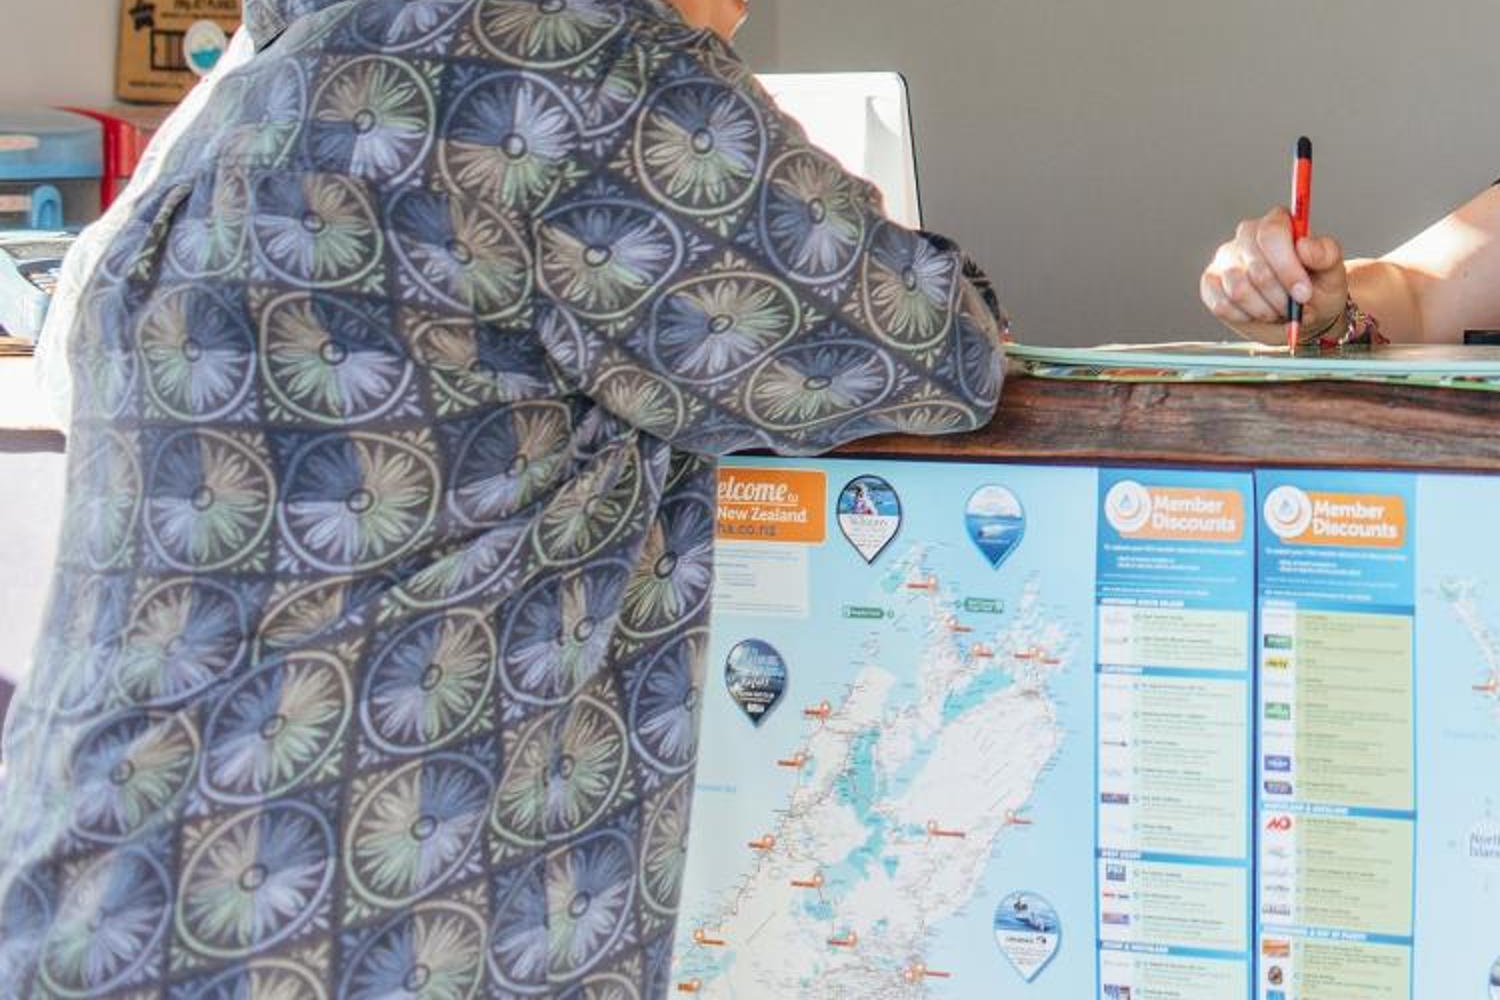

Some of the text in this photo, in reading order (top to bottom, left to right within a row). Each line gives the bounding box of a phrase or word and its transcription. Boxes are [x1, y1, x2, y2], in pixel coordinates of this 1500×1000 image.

[718, 476, 788, 502] elcome
[1152, 495, 1225, 513] Member
[1314, 500, 1385, 519] Member
[718, 506, 807, 523] New Zealand
[1152, 512, 1236, 532] Discounts
[1312, 517, 1399, 539] Discounts
